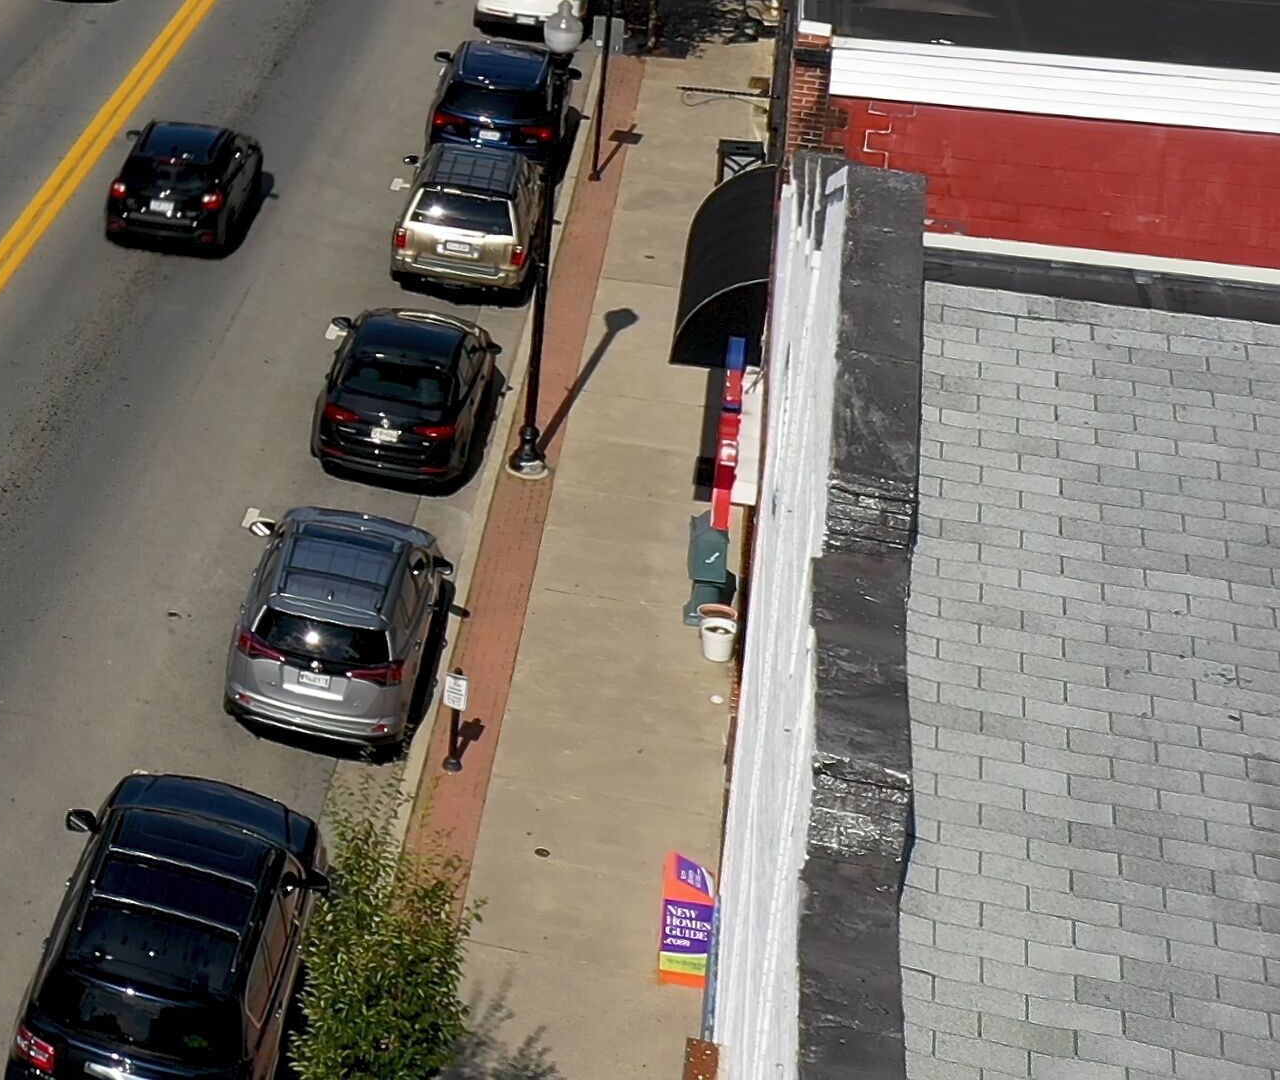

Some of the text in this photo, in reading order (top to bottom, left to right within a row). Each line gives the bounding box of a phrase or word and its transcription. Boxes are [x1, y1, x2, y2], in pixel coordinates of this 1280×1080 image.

[667, 904, 699, 919] NEW
[665, 915, 712, 931] HOMES
[665, 926, 708, 941] GUIDE
[663, 938, 691, 947] .com
